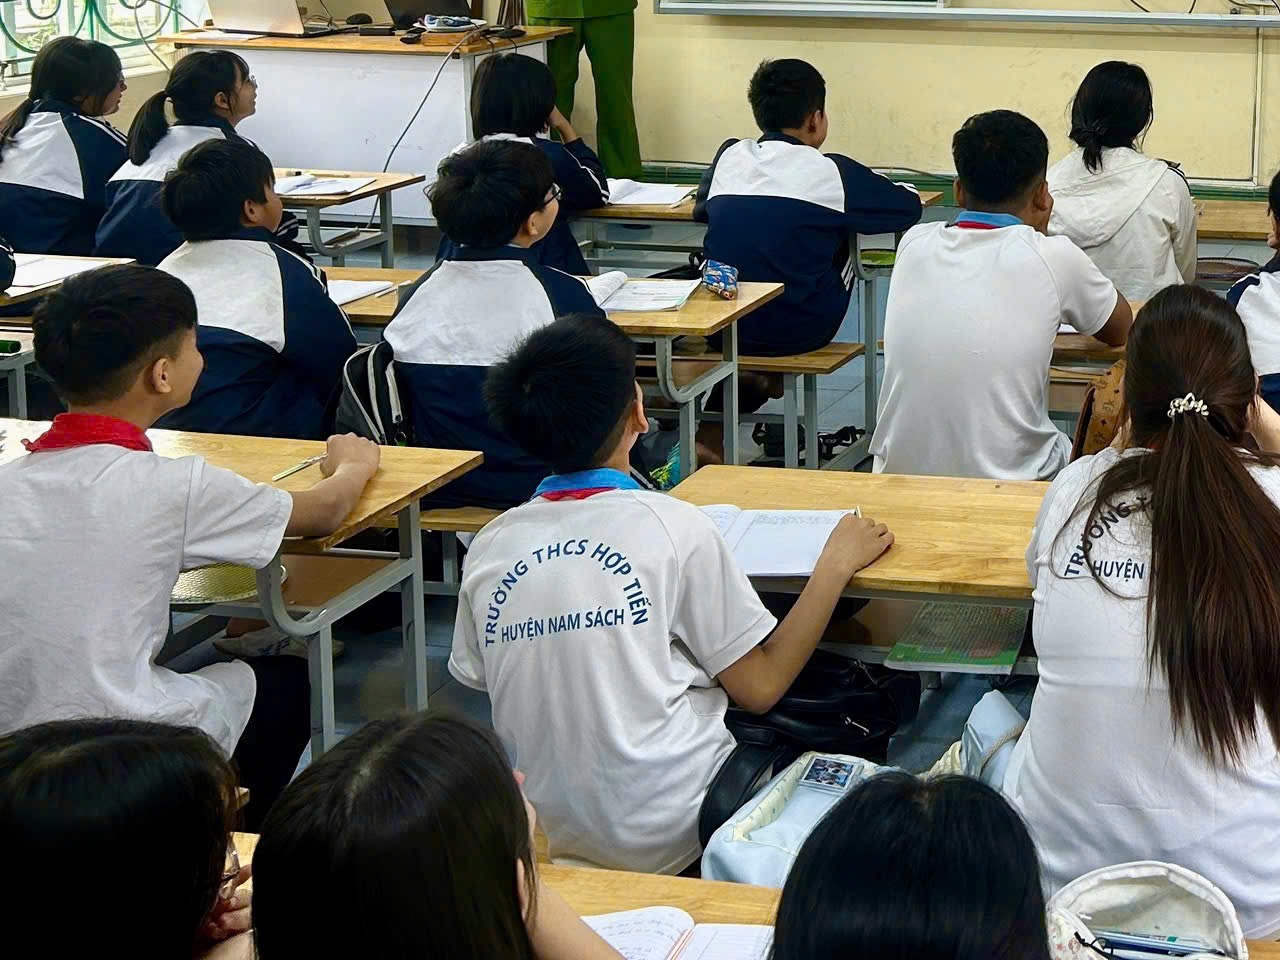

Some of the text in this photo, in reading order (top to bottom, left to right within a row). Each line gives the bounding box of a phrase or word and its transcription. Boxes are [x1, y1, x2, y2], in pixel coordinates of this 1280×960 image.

[1092, 558, 1144, 582] HUYỆN
[485, 539, 652, 647] TRƯỜNG THCS HỢP TIẾN
[502, 606, 624, 643] HUYỆN NAM SÁCH
